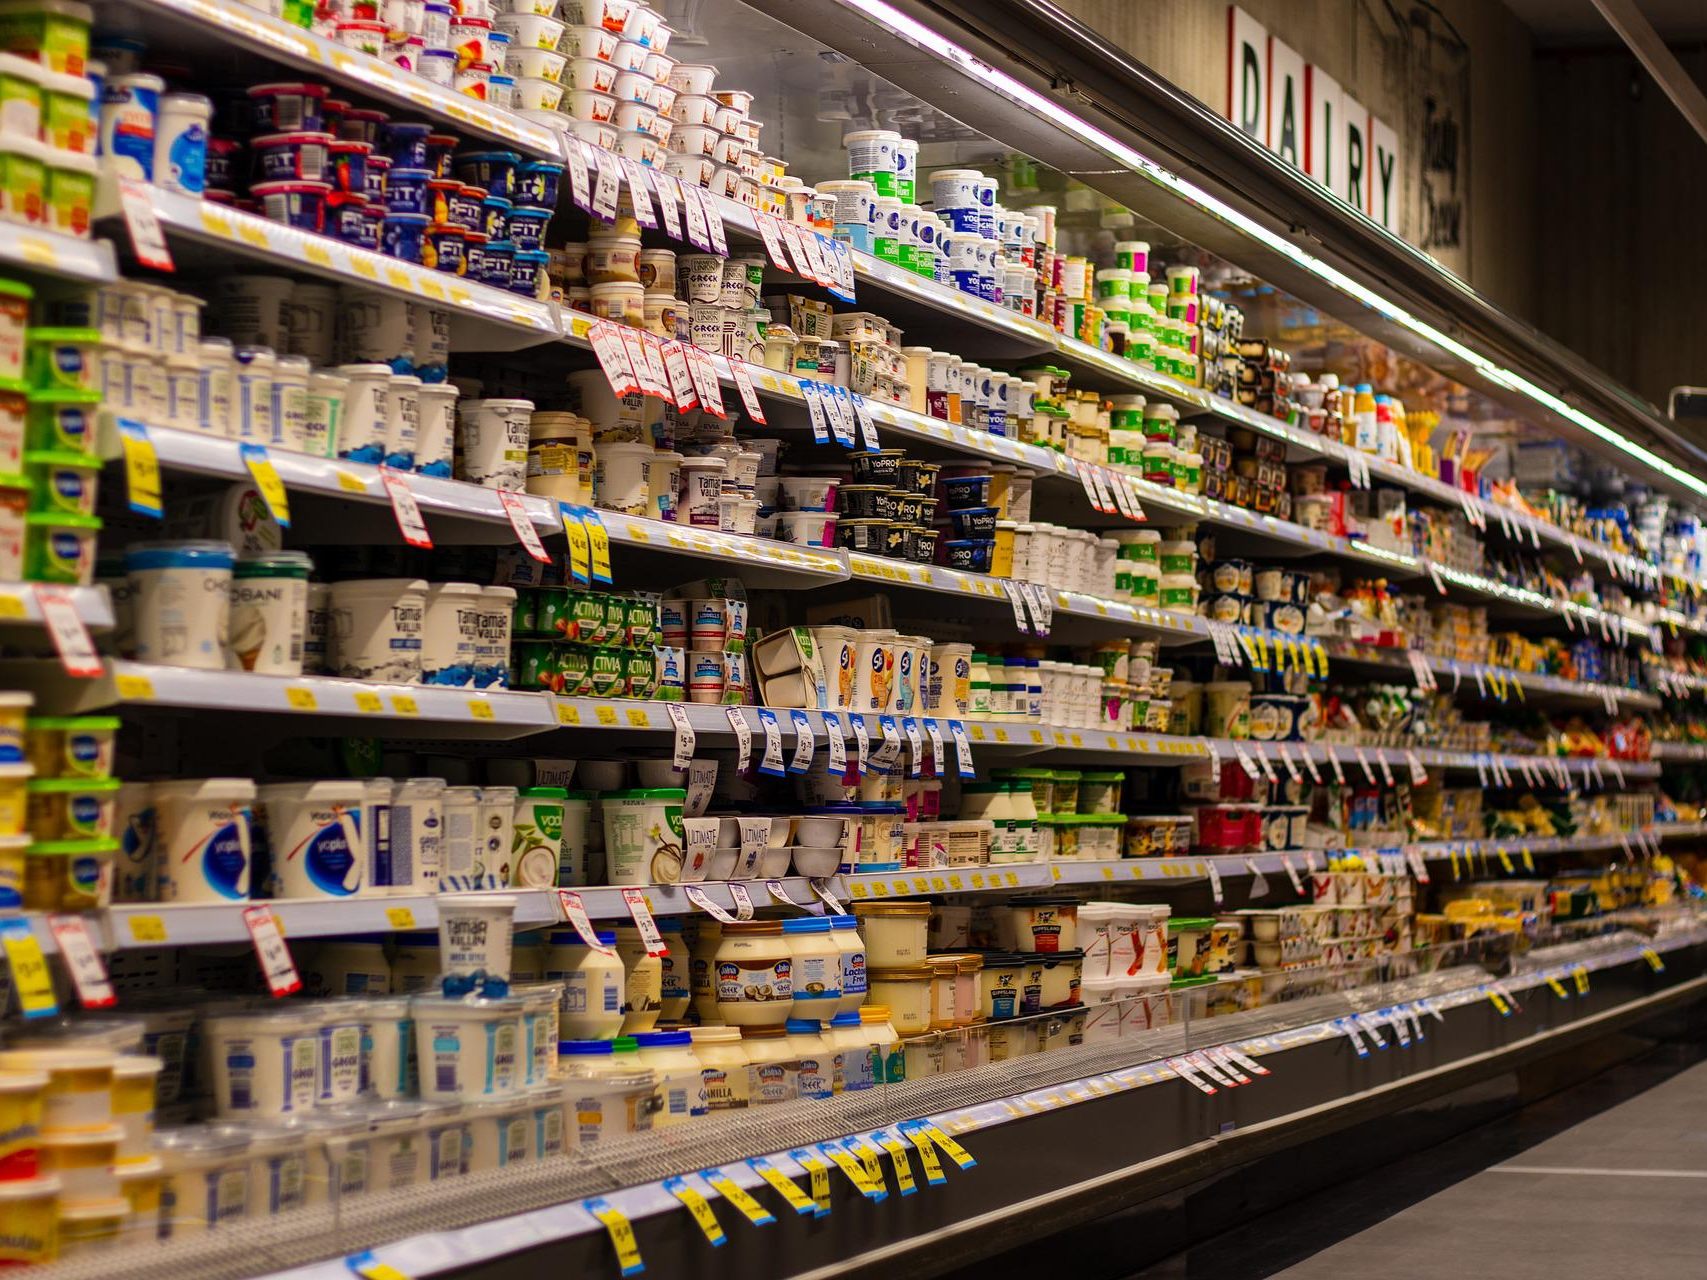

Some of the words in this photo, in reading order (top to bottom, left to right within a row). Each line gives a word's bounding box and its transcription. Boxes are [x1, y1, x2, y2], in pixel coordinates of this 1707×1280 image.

[1243, 41, 1393, 227] DAIRY
[688, 829, 717, 846] ULTIMATE
[741, 828, 768, 845] ULTIMATE
